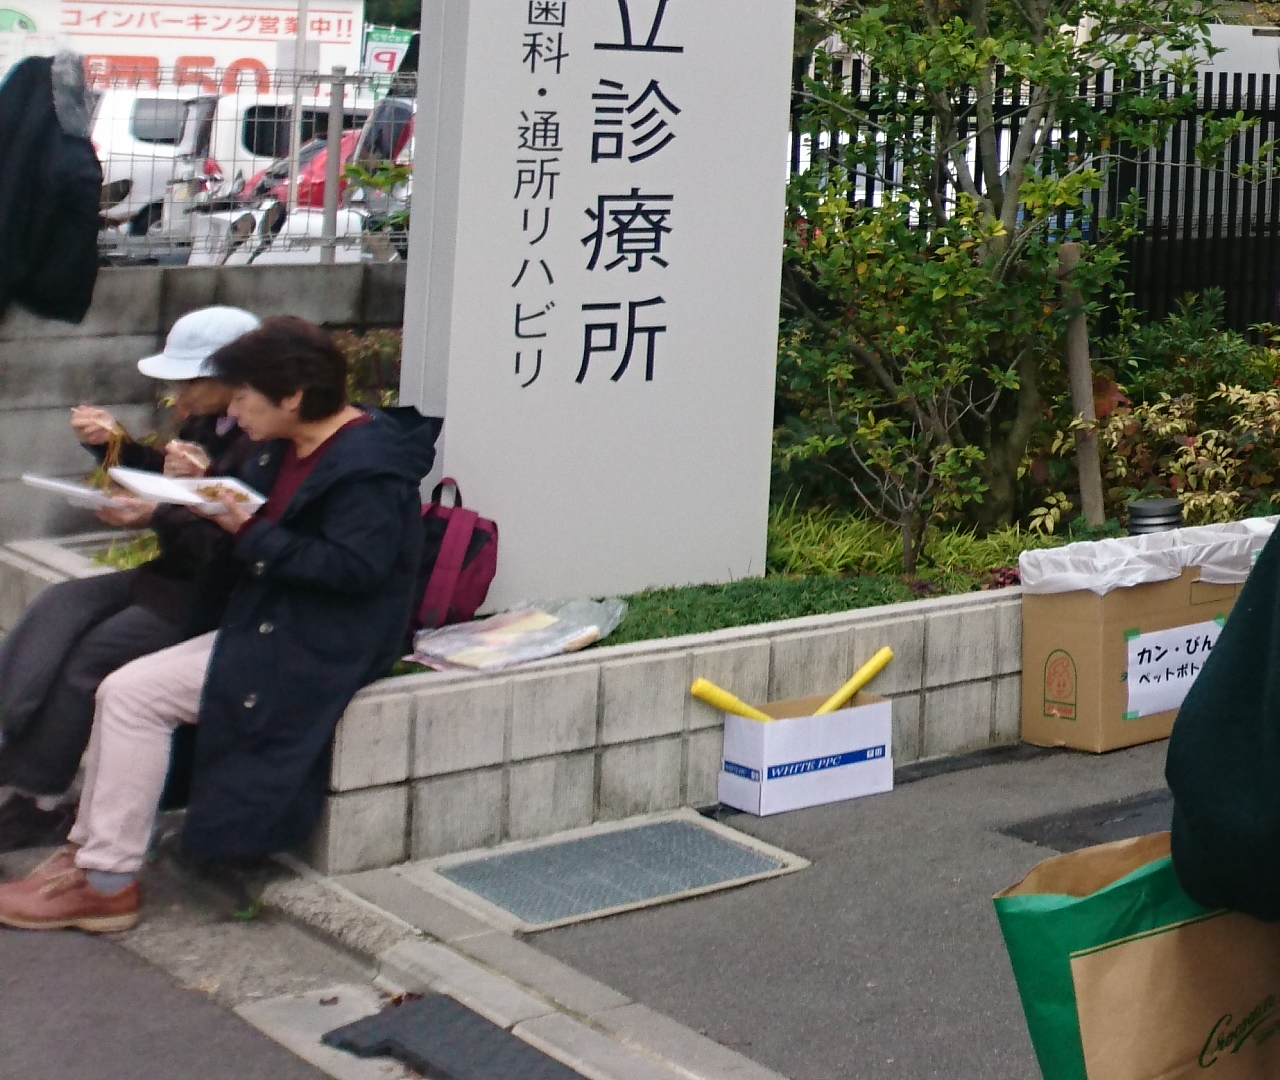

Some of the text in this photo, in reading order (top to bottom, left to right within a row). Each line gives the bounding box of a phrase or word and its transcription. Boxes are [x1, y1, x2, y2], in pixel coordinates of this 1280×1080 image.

[1138, 661, 1206, 684] ペットボト
[771, 760, 816, 778] WHITE
